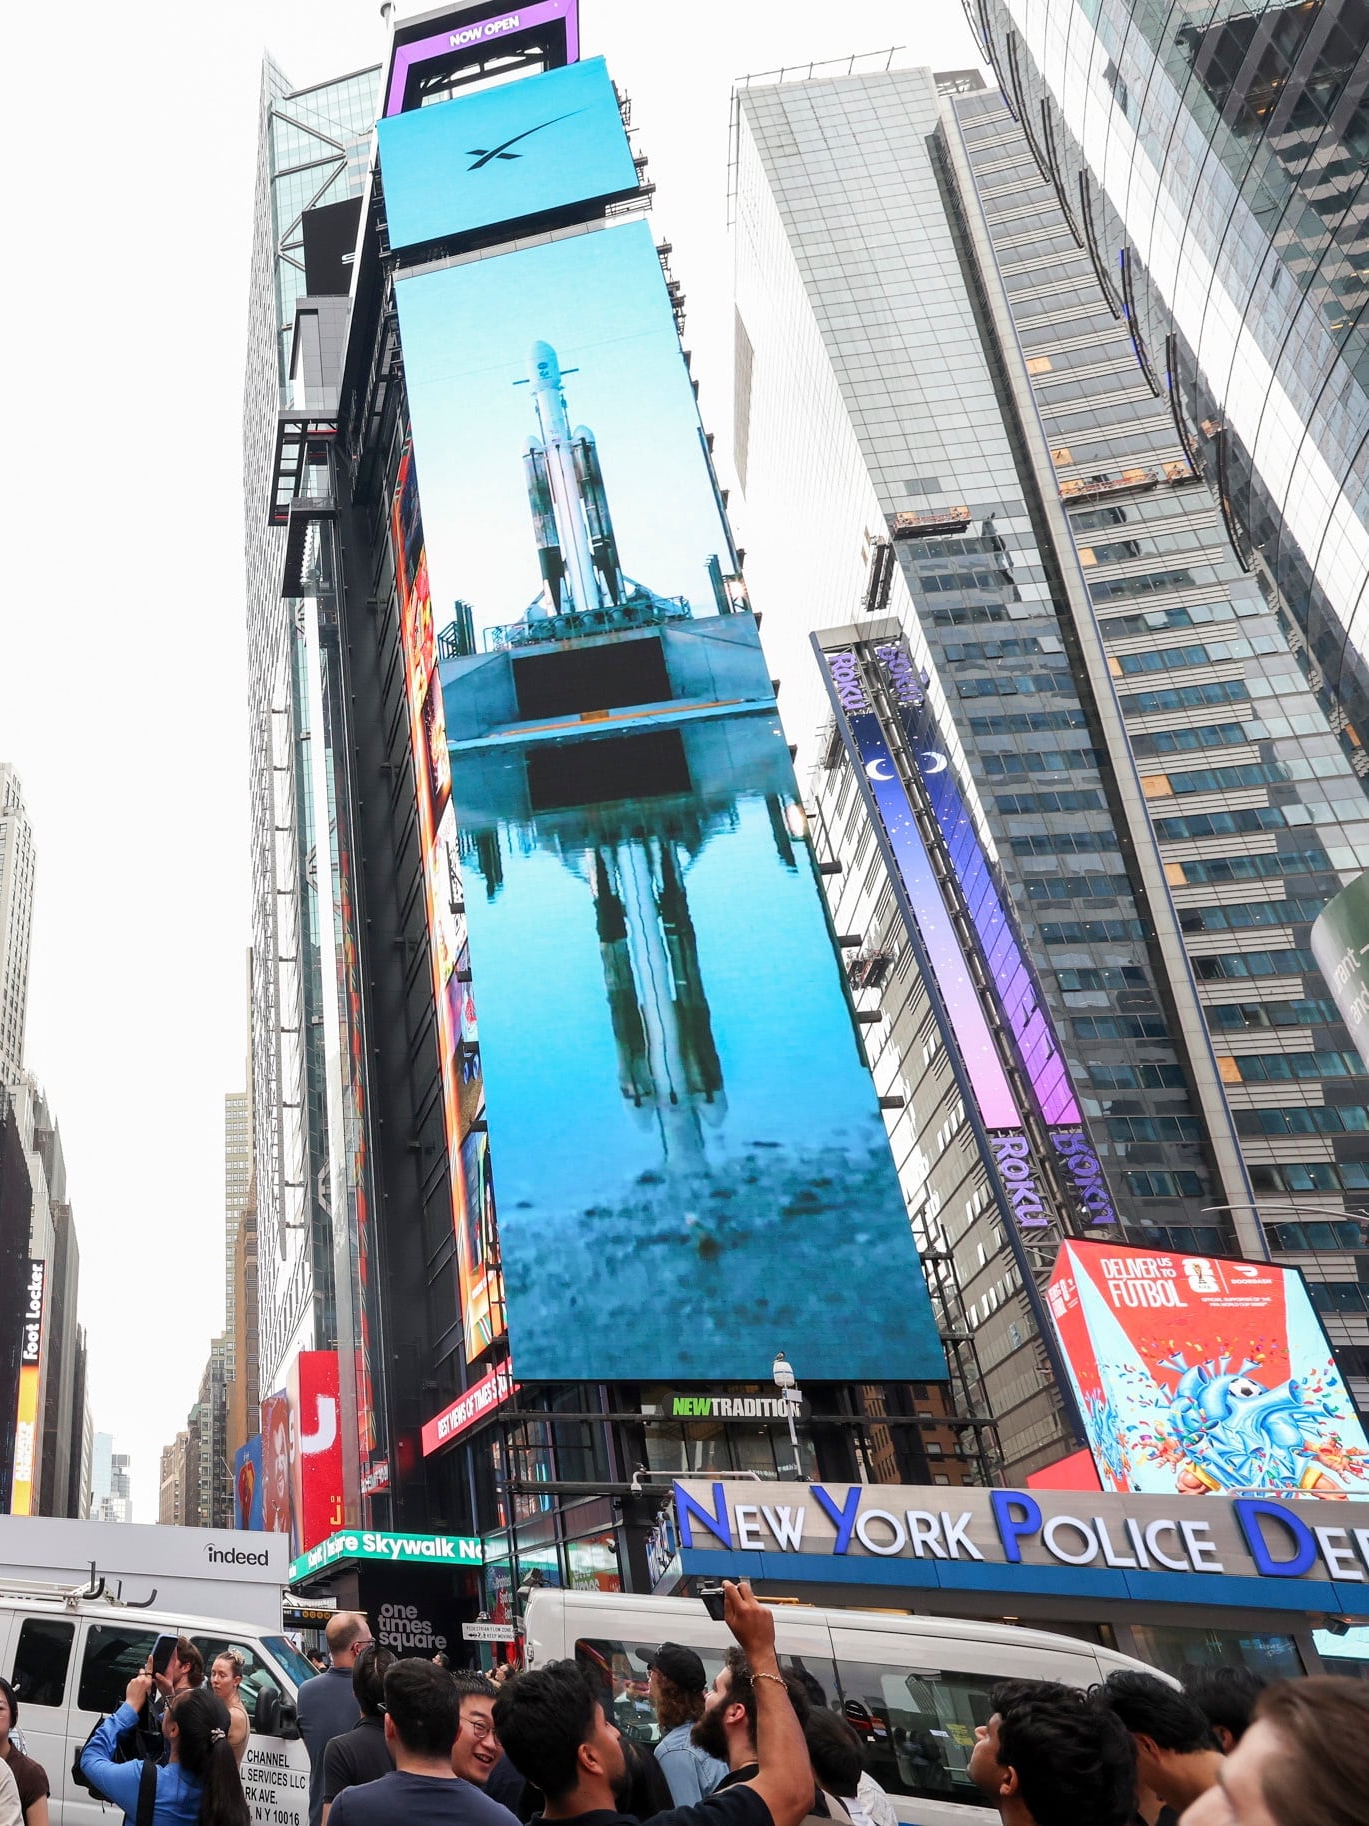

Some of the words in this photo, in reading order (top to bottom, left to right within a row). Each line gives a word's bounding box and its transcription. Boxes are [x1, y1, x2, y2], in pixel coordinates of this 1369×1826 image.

[449, 26, 482, 47] NOW
[485, 15, 519, 36] OPEN
[829, 653, 866, 711] ROKU
[990, 1136, 1048, 1227] ROKU
[1100, 1258, 1158, 1279] DELIVER
[1157, 1257, 1173, 1267] US
[1160, 1268, 1176, 1278] TO
[26, 1263, 44, 1319] Locker
[1108, 1278, 1189, 1308] FÚTBOL
[23, 1323, 40, 1360] Foot
[437, 1413, 450, 1439] BEST
[450, 1401, 466, 1430] VIEWS
[465, 1396, 474, 1417] OF
[473, 1382, 492, 1412] TIMES
[206, 1543, 269, 1566] indeed
[362, 1534, 455, 1560] Skywalk
[381, 1603, 417, 1619] one
[378, 1615, 432, 1634] times
[379, 1632, 447, 1652] square
[247, 1750, 290, 1768] CHANNEL
[247, 1768, 287, 1787] SERVICES
[290, 1774, 306, 1789] LLC
[259, 1788, 278, 1804] AVE.
[273, 1809, 300, 1825] 10016
